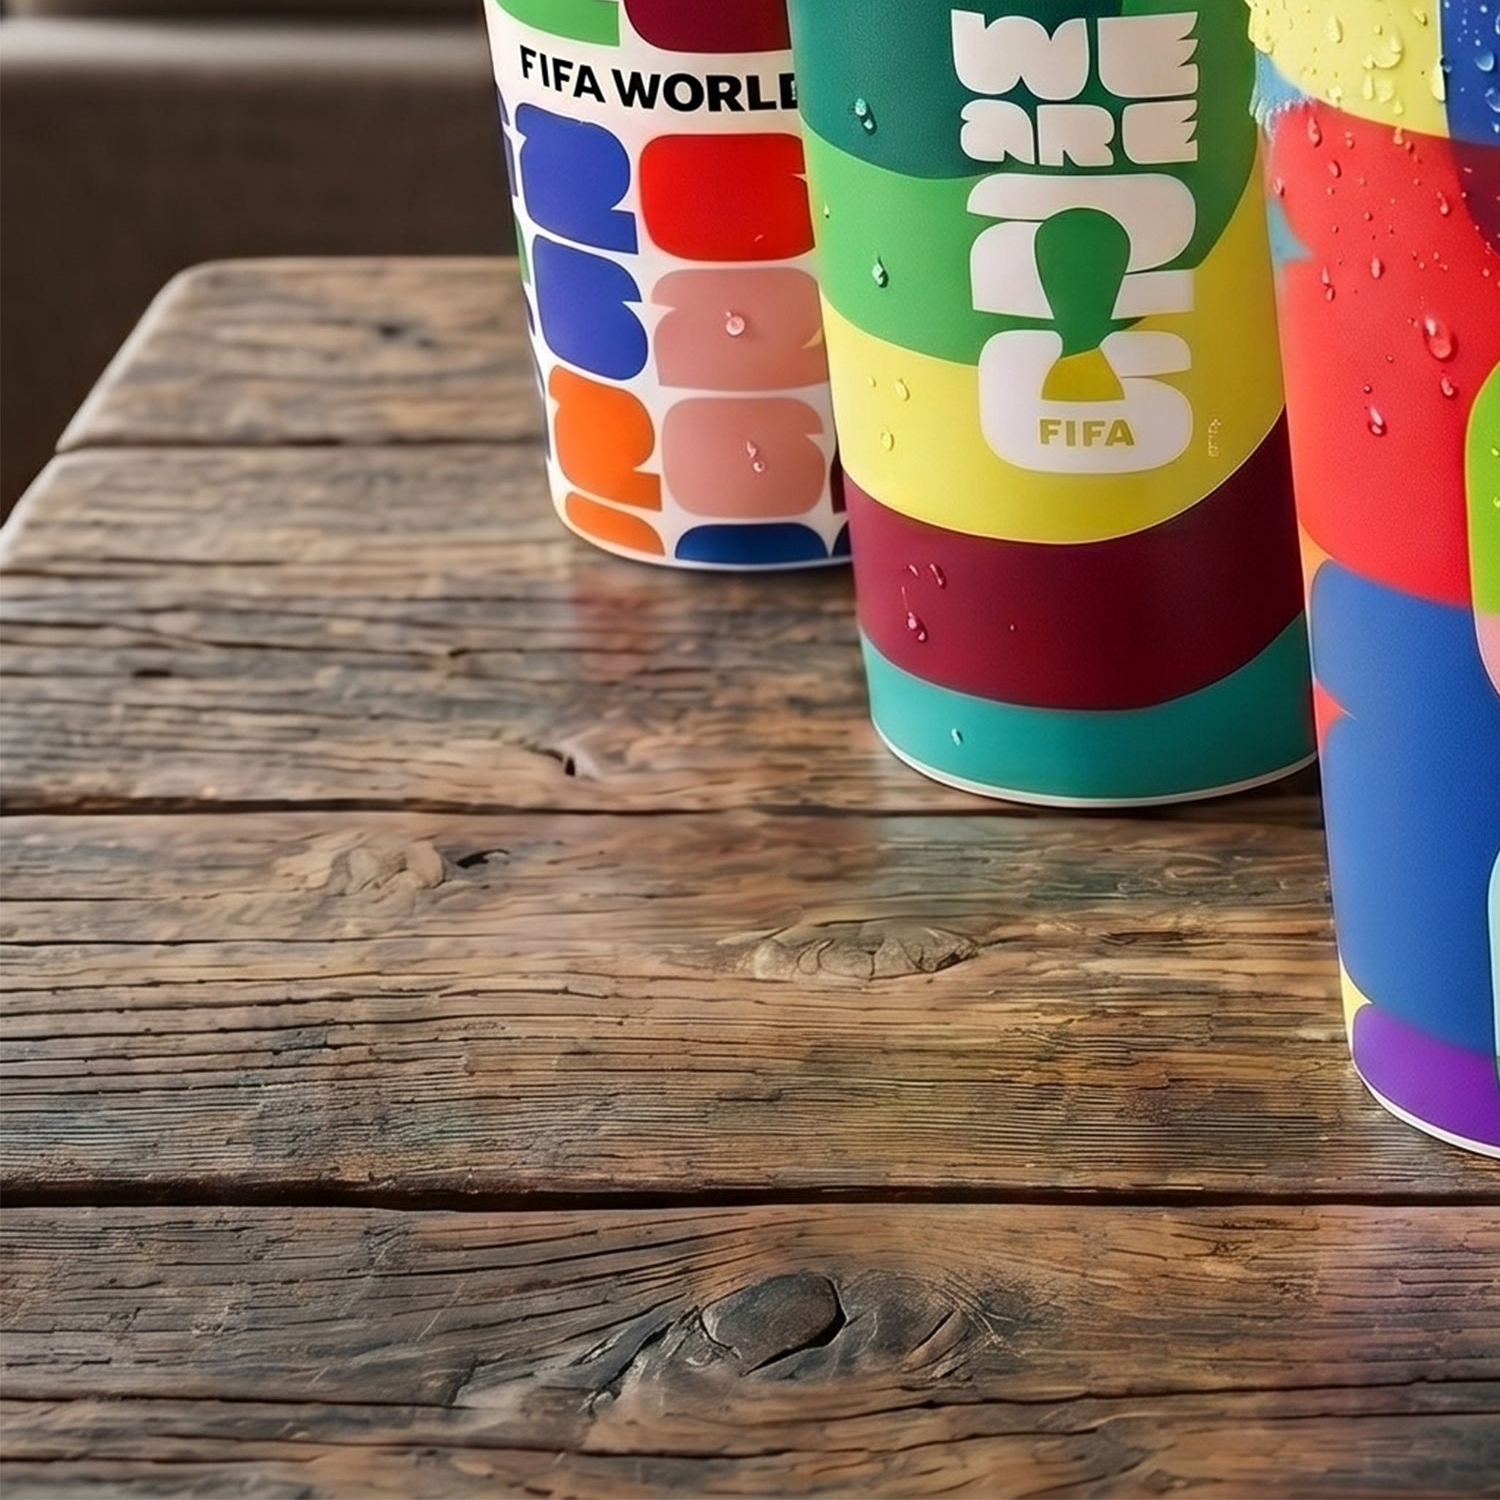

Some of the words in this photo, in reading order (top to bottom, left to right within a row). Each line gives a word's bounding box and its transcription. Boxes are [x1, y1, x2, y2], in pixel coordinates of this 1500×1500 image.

[520, 44, 606, 103] FIFA
[951, 8, 1198, 100] WE
[1039, 418, 1136, 447] FIFA
